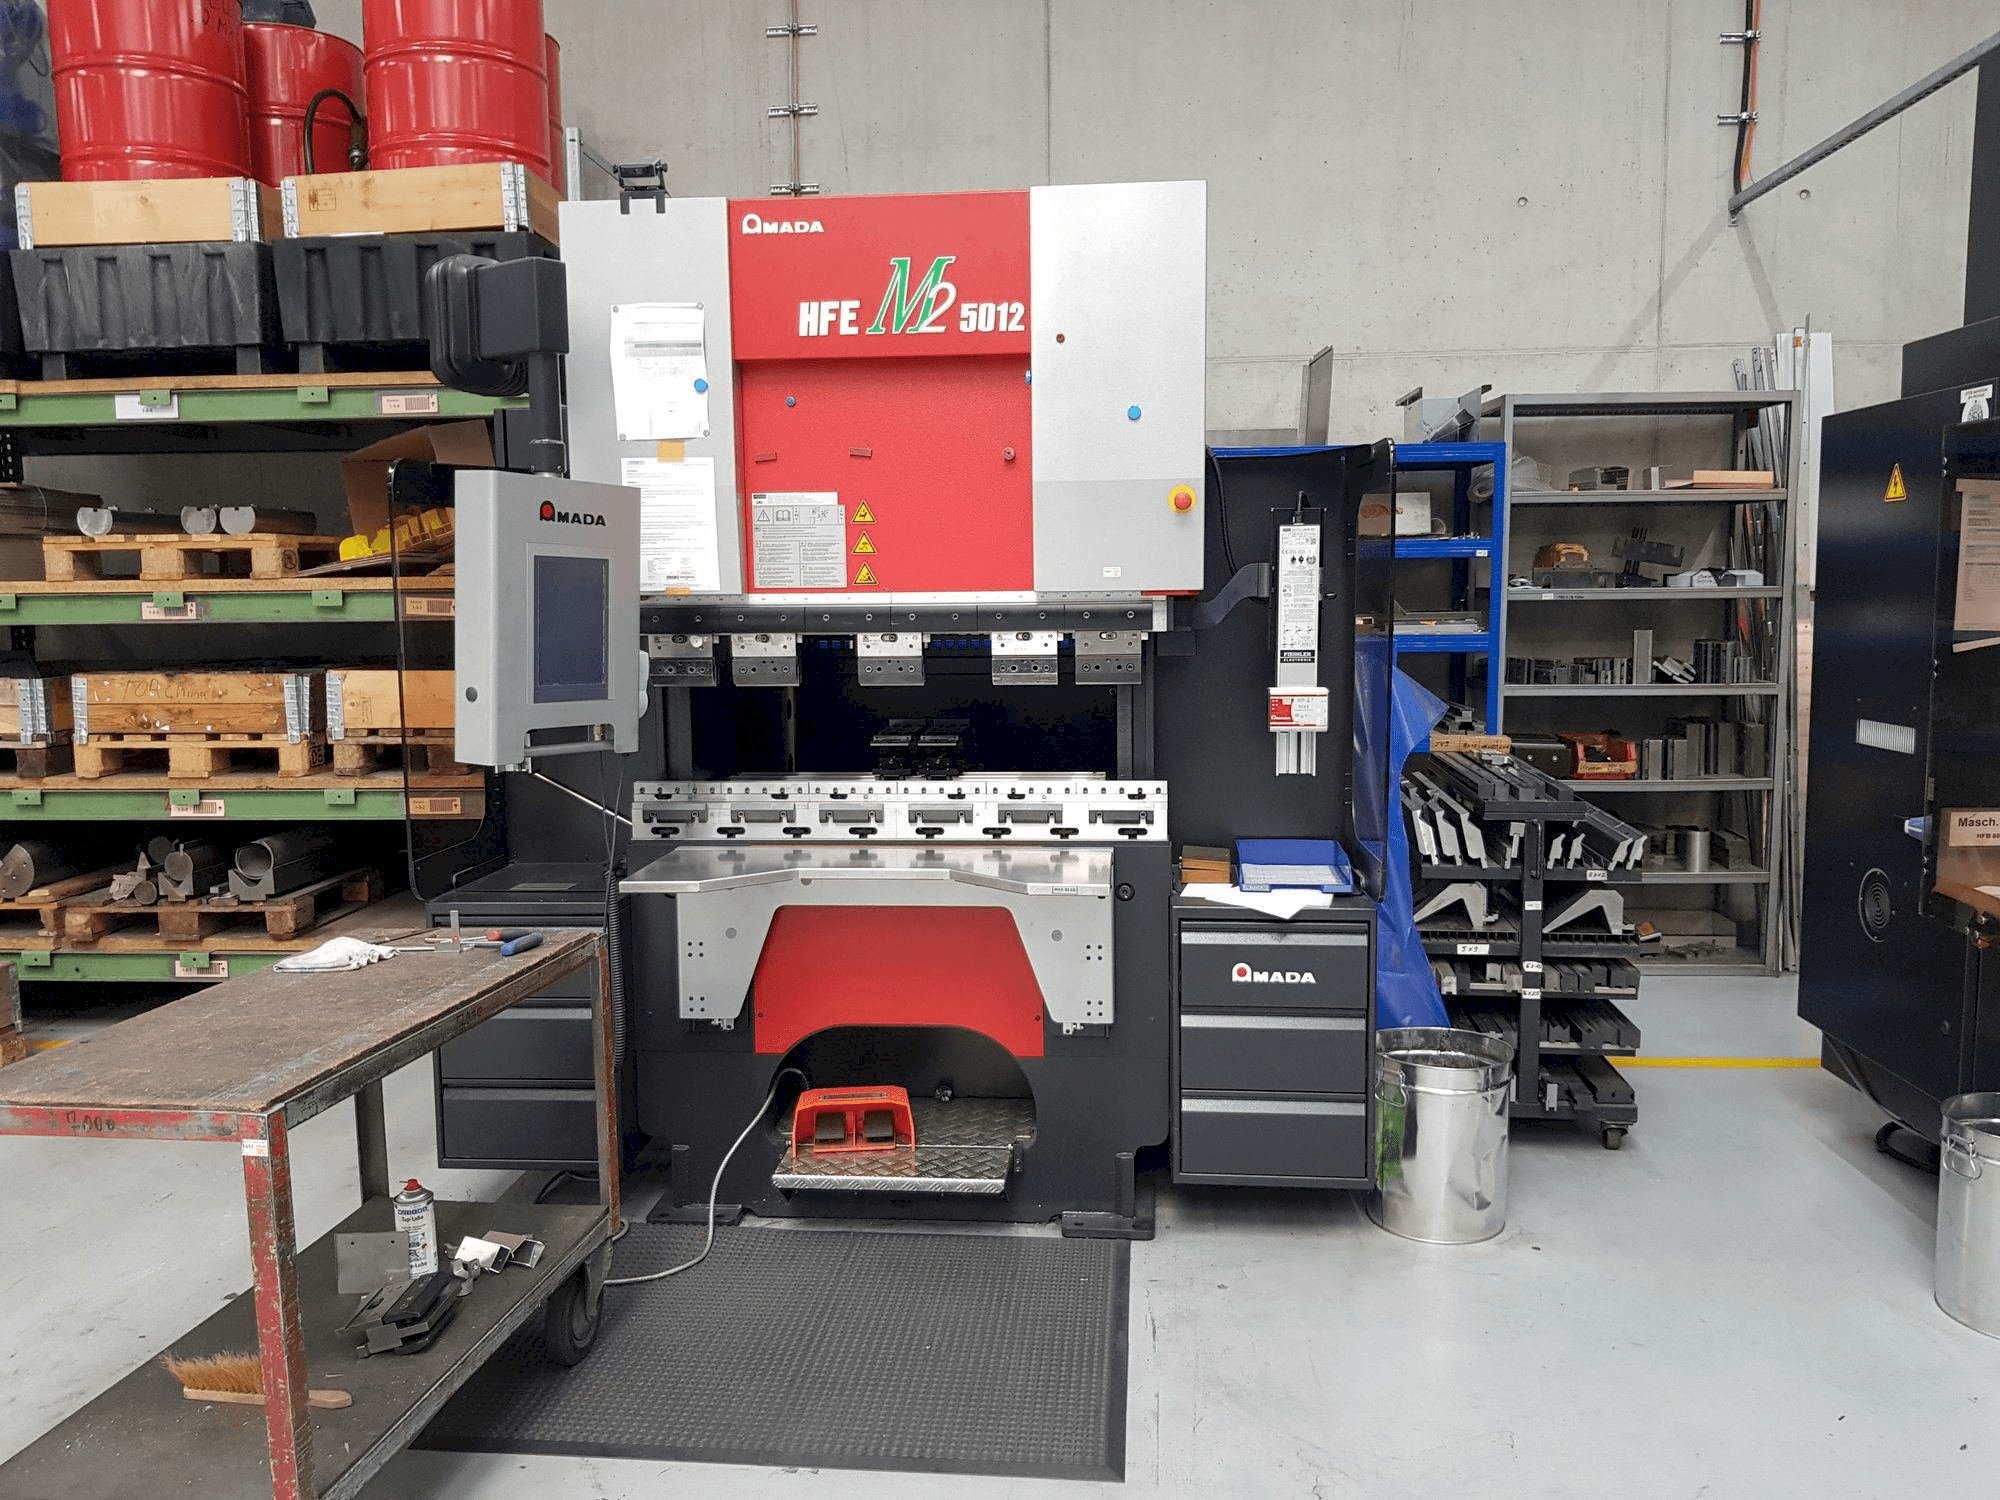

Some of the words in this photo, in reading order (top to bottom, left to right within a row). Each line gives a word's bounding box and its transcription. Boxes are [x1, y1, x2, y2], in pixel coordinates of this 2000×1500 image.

[742, 213, 825, 235] AMADA
[799, 299, 861, 337] HFE
[959, 301, 1025, 333] 5012
[540, 500, 607, 527] AMADA
[1958, 817, 1999, 827] Masch.
[1231, 962, 1317, 984] AMADA
[410, 1261, 428, 1270] p-Lube
